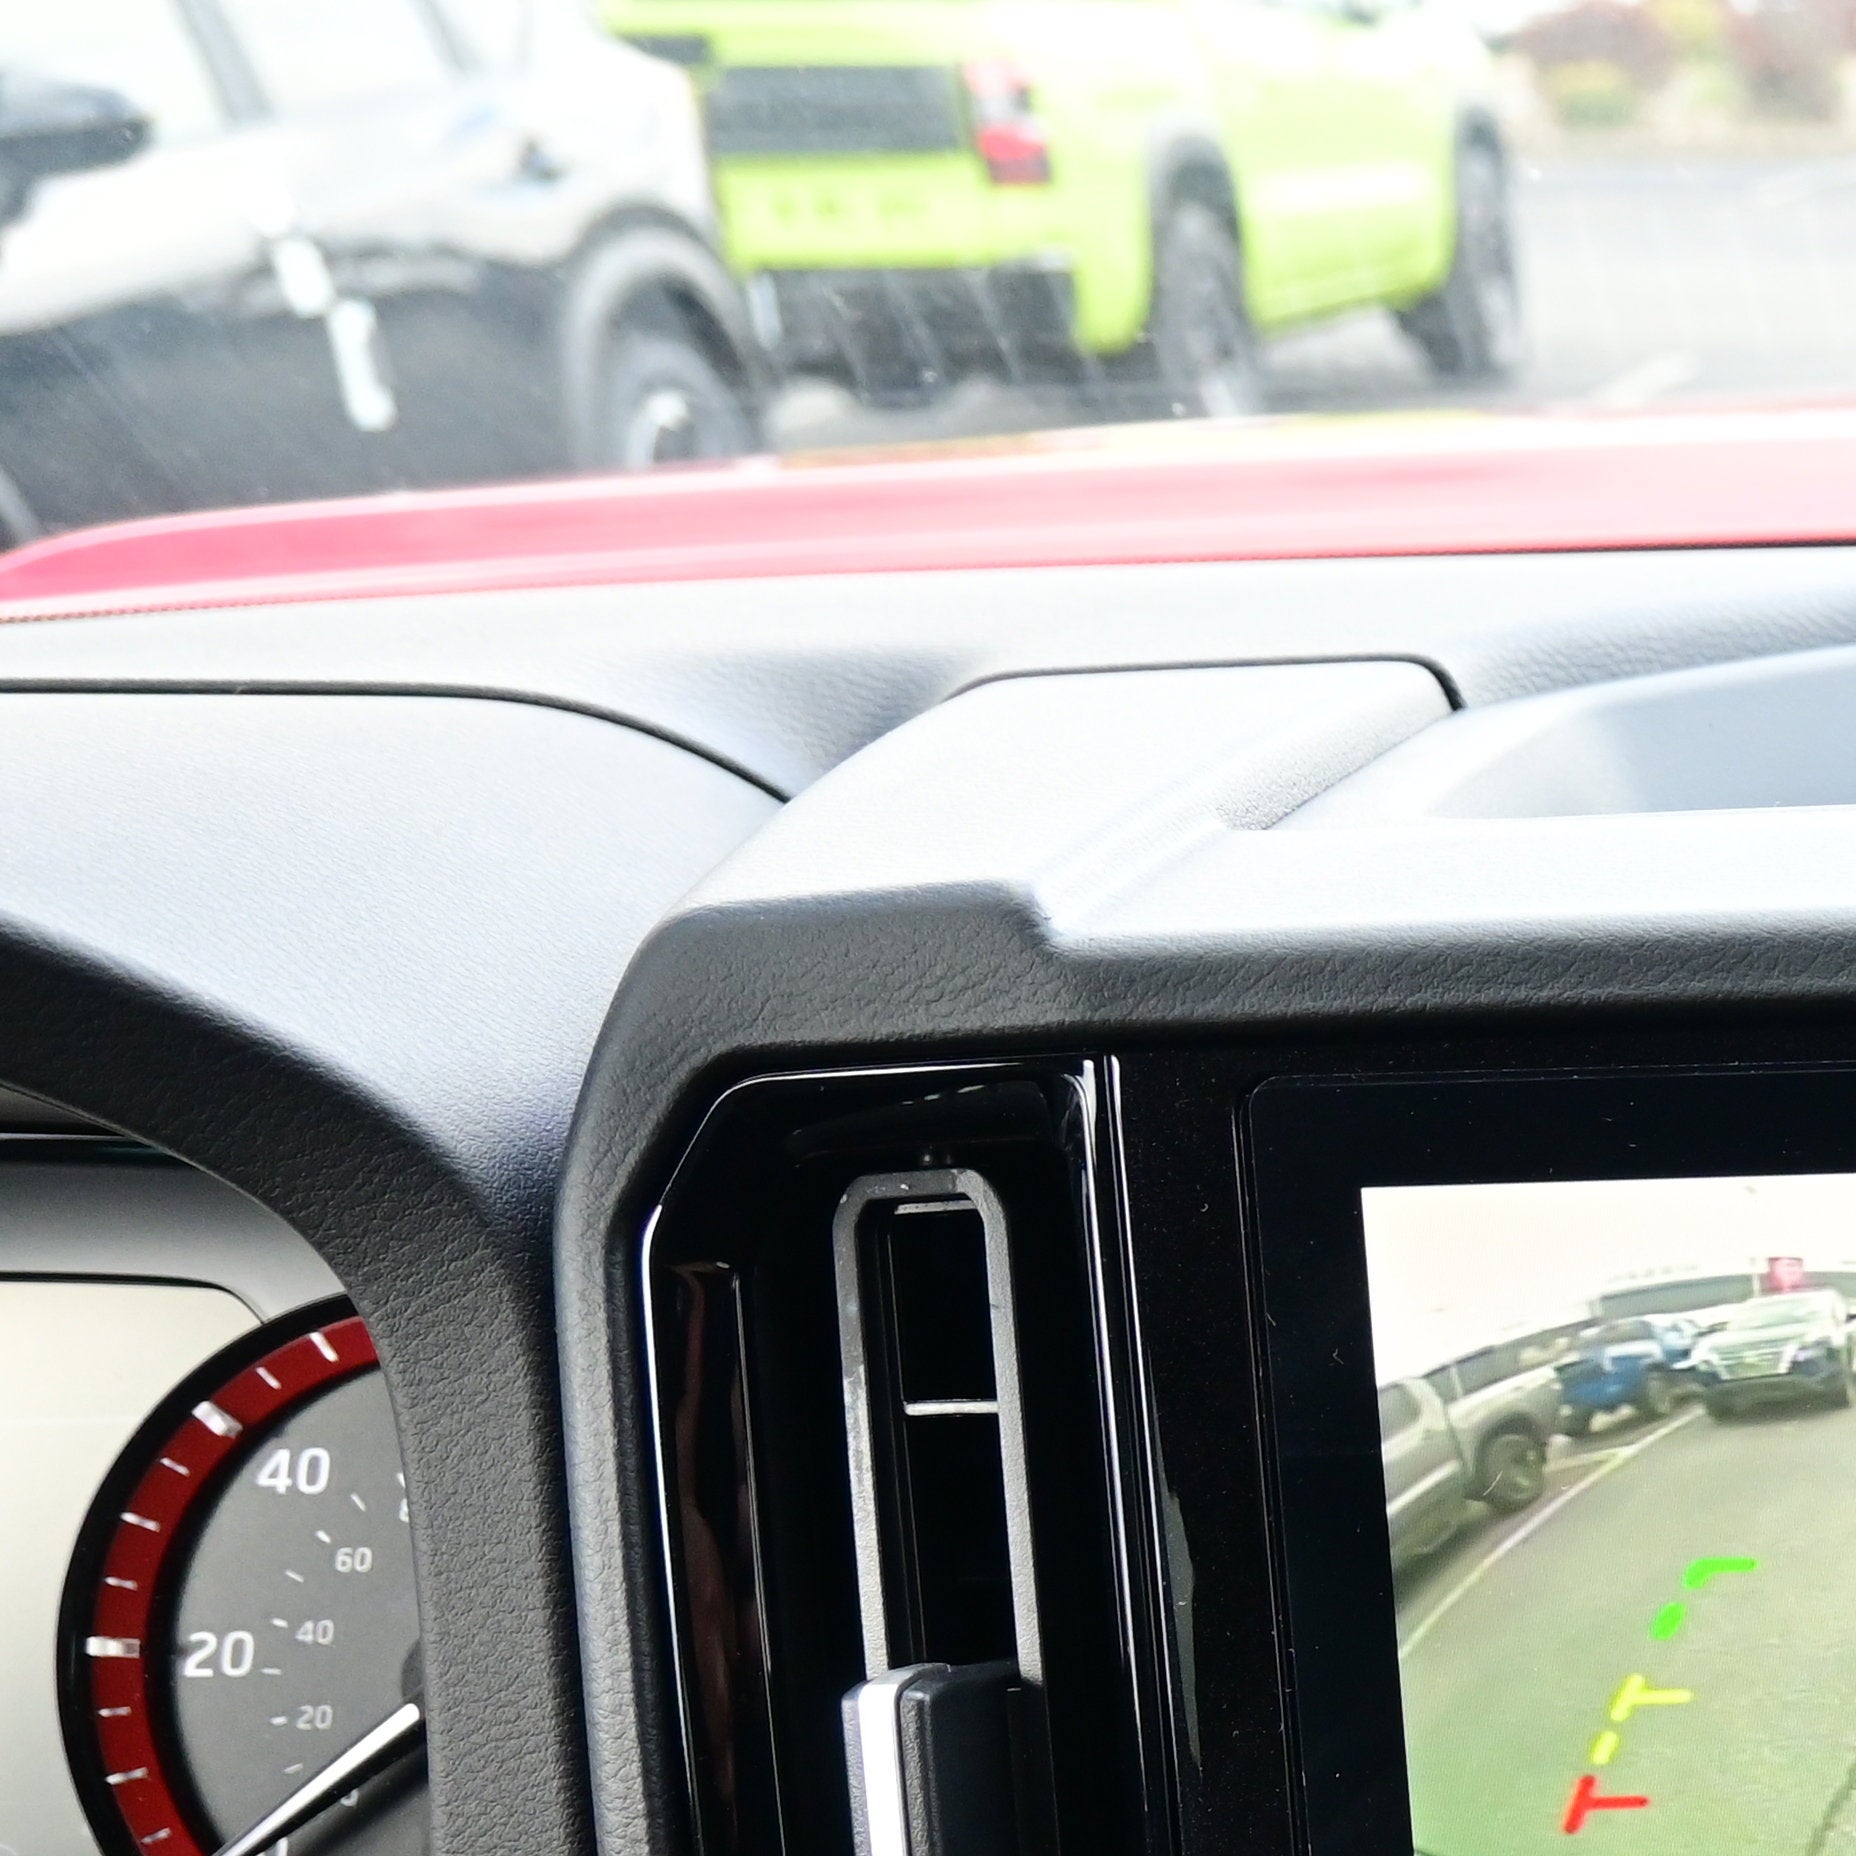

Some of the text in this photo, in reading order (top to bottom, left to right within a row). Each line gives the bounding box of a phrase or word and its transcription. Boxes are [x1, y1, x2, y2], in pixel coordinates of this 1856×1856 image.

[257, 1447, 331, 1495] 40
[335, 1546, 373, 1574] 60
[295, 1617, 335, 1646] 40
[183, 1630, 255, 1679] 20
[295, 1704, 333, 1732] 20
